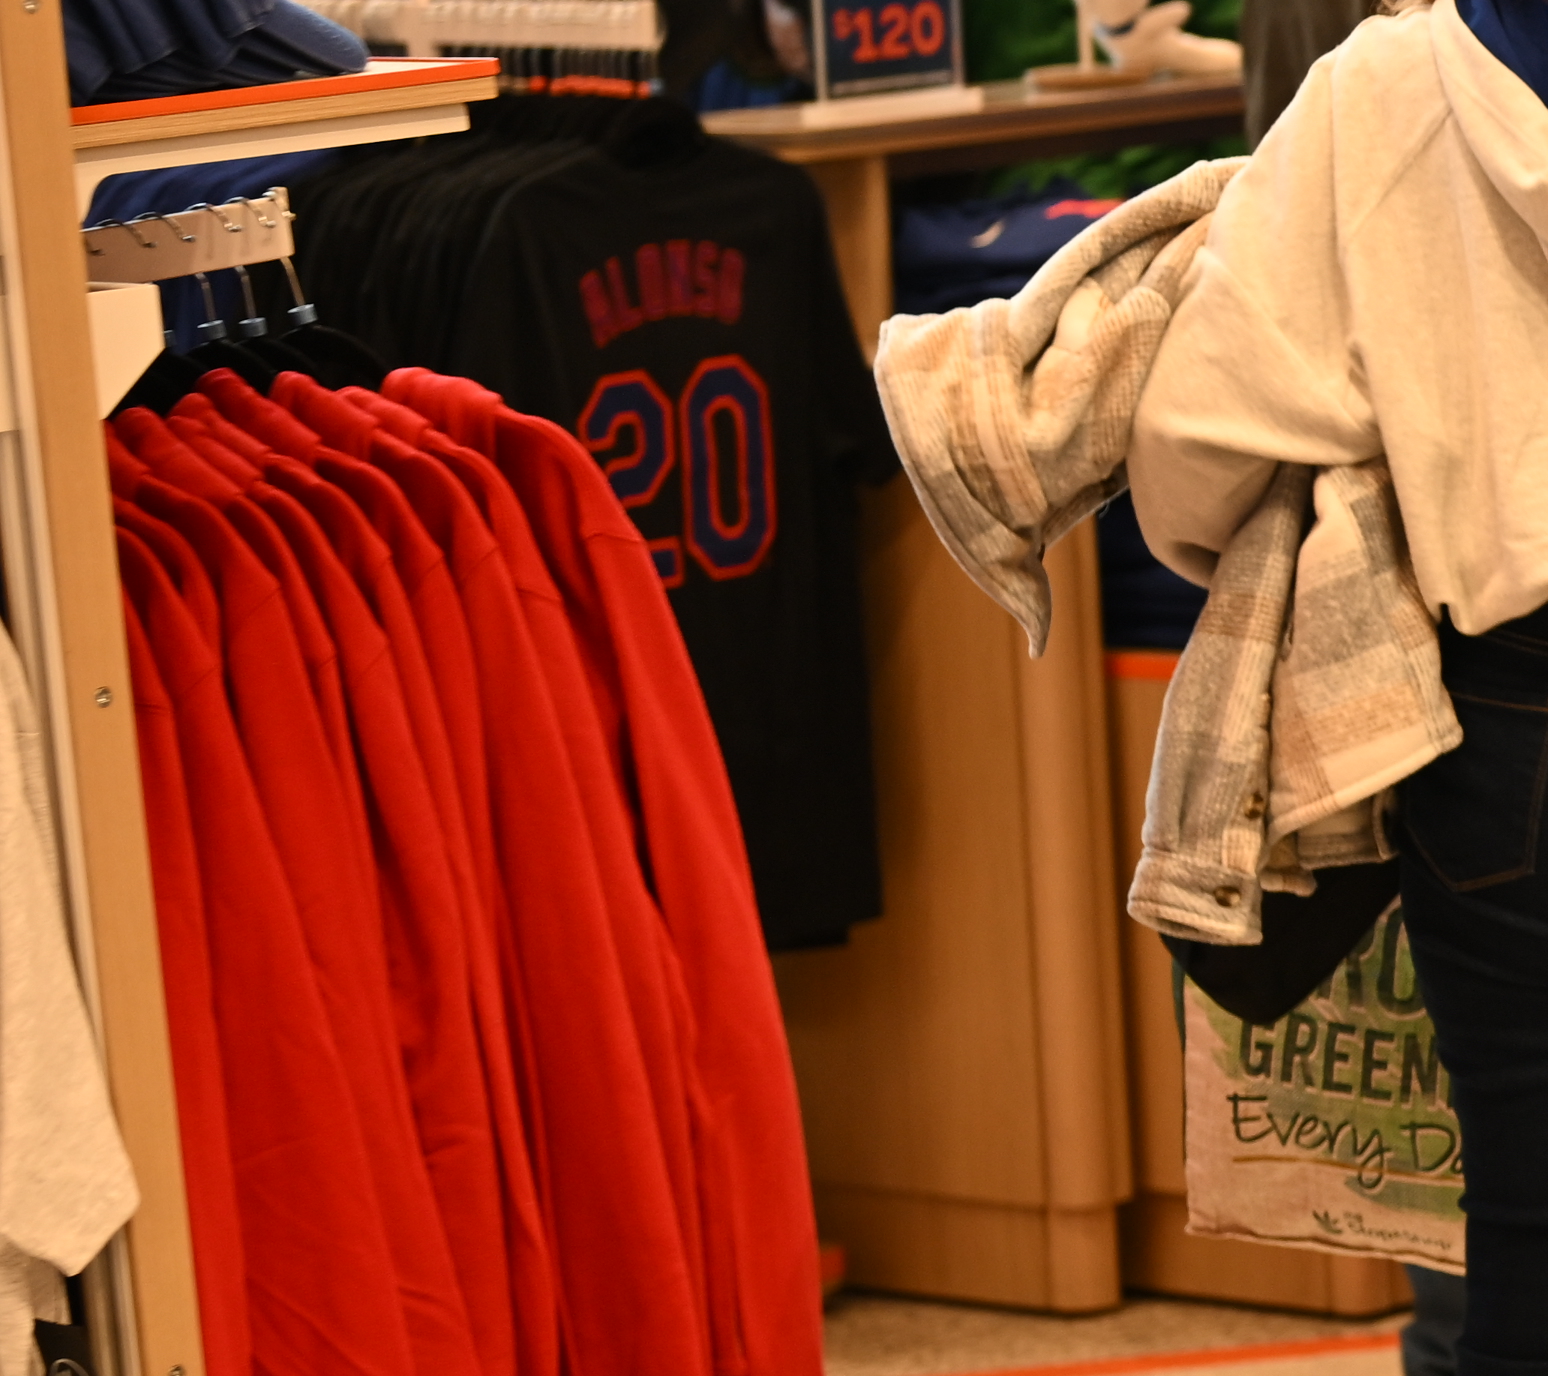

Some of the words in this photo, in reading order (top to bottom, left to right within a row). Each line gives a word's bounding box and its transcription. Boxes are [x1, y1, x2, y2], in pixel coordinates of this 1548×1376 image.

[831, 0, 946, 64] $120
[578, 238, 745, 349] ALONSO
[577, 353, 778, 589] 20
[1226, 1091, 1394, 1190] Every
